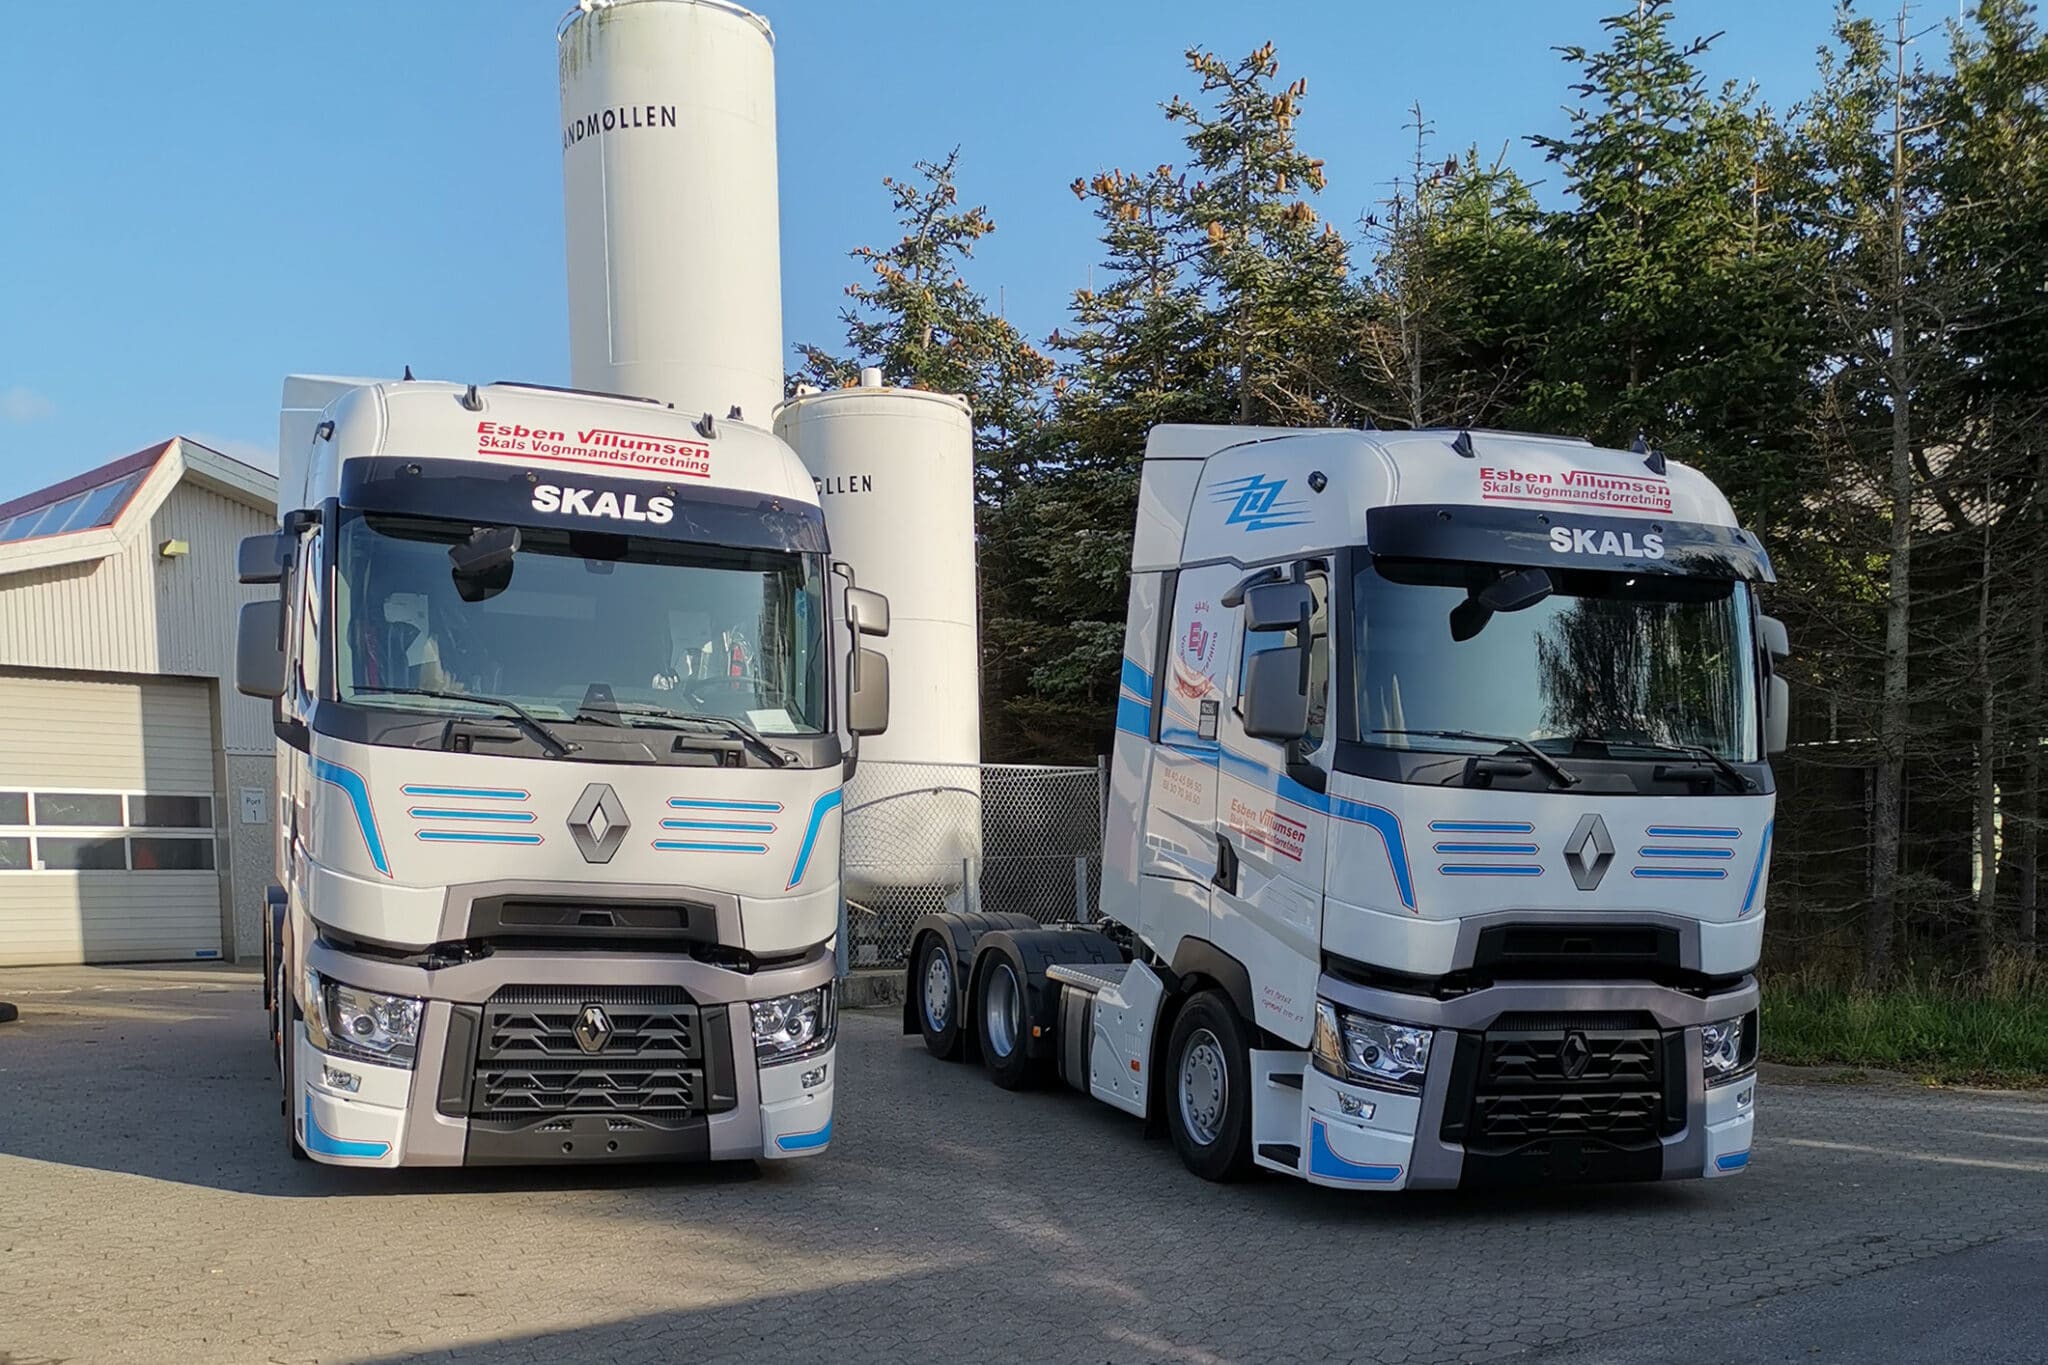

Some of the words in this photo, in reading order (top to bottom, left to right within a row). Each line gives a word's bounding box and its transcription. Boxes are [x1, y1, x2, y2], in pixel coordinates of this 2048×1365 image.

[477, 421, 565, 441] Esben
[577, 428, 710, 459] Villumsen
[478, 435, 526, 450] Skals
[531, 440, 710, 472] Vognmandsforretning
[1479, 467, 1552, 483] Esben
[1561, 470, 1671, 496] Villumsen
[1482, 480, 1522, 494] Skals
[1526, 483, 1672, 510] Vognmandsforretning
[531, 484, 675, 524] SKALS
[1550, 526, 1665, 560] SKALS
[246, 796, 261, 805] Port
[1231, 798, 1256, 821] Esben
[1259, 808, 1306, 843] Villumsen
